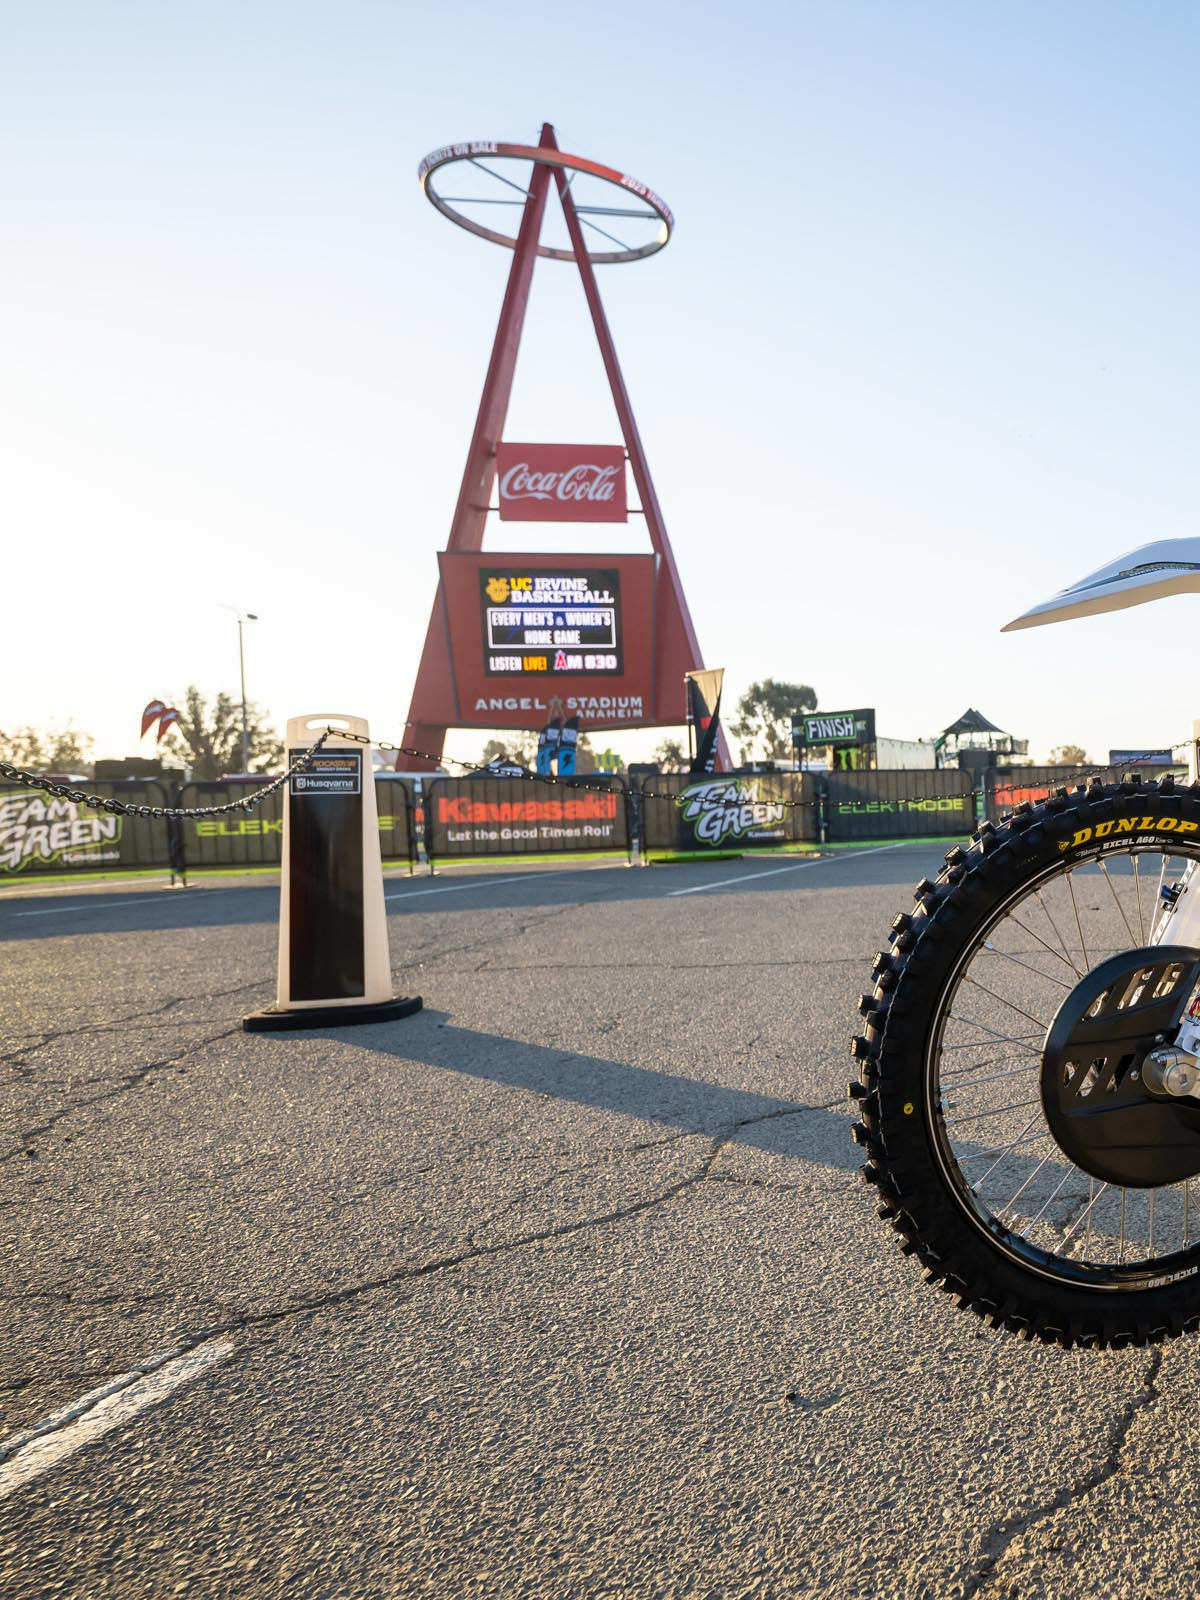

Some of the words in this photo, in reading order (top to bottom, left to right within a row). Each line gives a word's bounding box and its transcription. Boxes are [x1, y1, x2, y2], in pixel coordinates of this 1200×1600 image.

[501, 463, 621, 501] Coca-Cola
[510, 577, 532, 591] UC
[534, 577, 587, 591] IRVINE
[511, 590, 614, 603] BASKETBALL
[491, 611, 522, 626] EVERY
[523, 611, 554, 626] MEN'S
[555, 616, 564, 626] &
[565, 611, 611, 626] WOMEN'S
[524, 629, 552, 645] HOME
[553, 629, 581, 645] GAME
[489, 656, 522, 671] LISTEN
[523, 656, 547, 671] LIVE!
[584, 654, 617, 670] 830
[475, 697, 546, 711] ANGEL
[566, 696, 643, 710] STADIUM
[576, 709, 643, 719] ANAHEIM
[807, 717, 853, 740] FINISH
[306, 779, 353, 790] Husqvarna
[684, 780, 759, 817] TEAM
[438, 793, 617, 824] Kawasaki
[697, 803, 784, 842] GREEN
[447, 829, 472, 842] Let
[474, 829, 498, 841] the
[500, 827, 538, 840] Good
[540, 826, 581, 838] Times
[583, 824, 611, 837] Roll
[1070, 816, 1200, 847] DUNLOP
[0, 815, 117, 869] GREEN
[1103, 837, 1135, 850] EXCEL
[1136, 836, 1155, 844] A60
